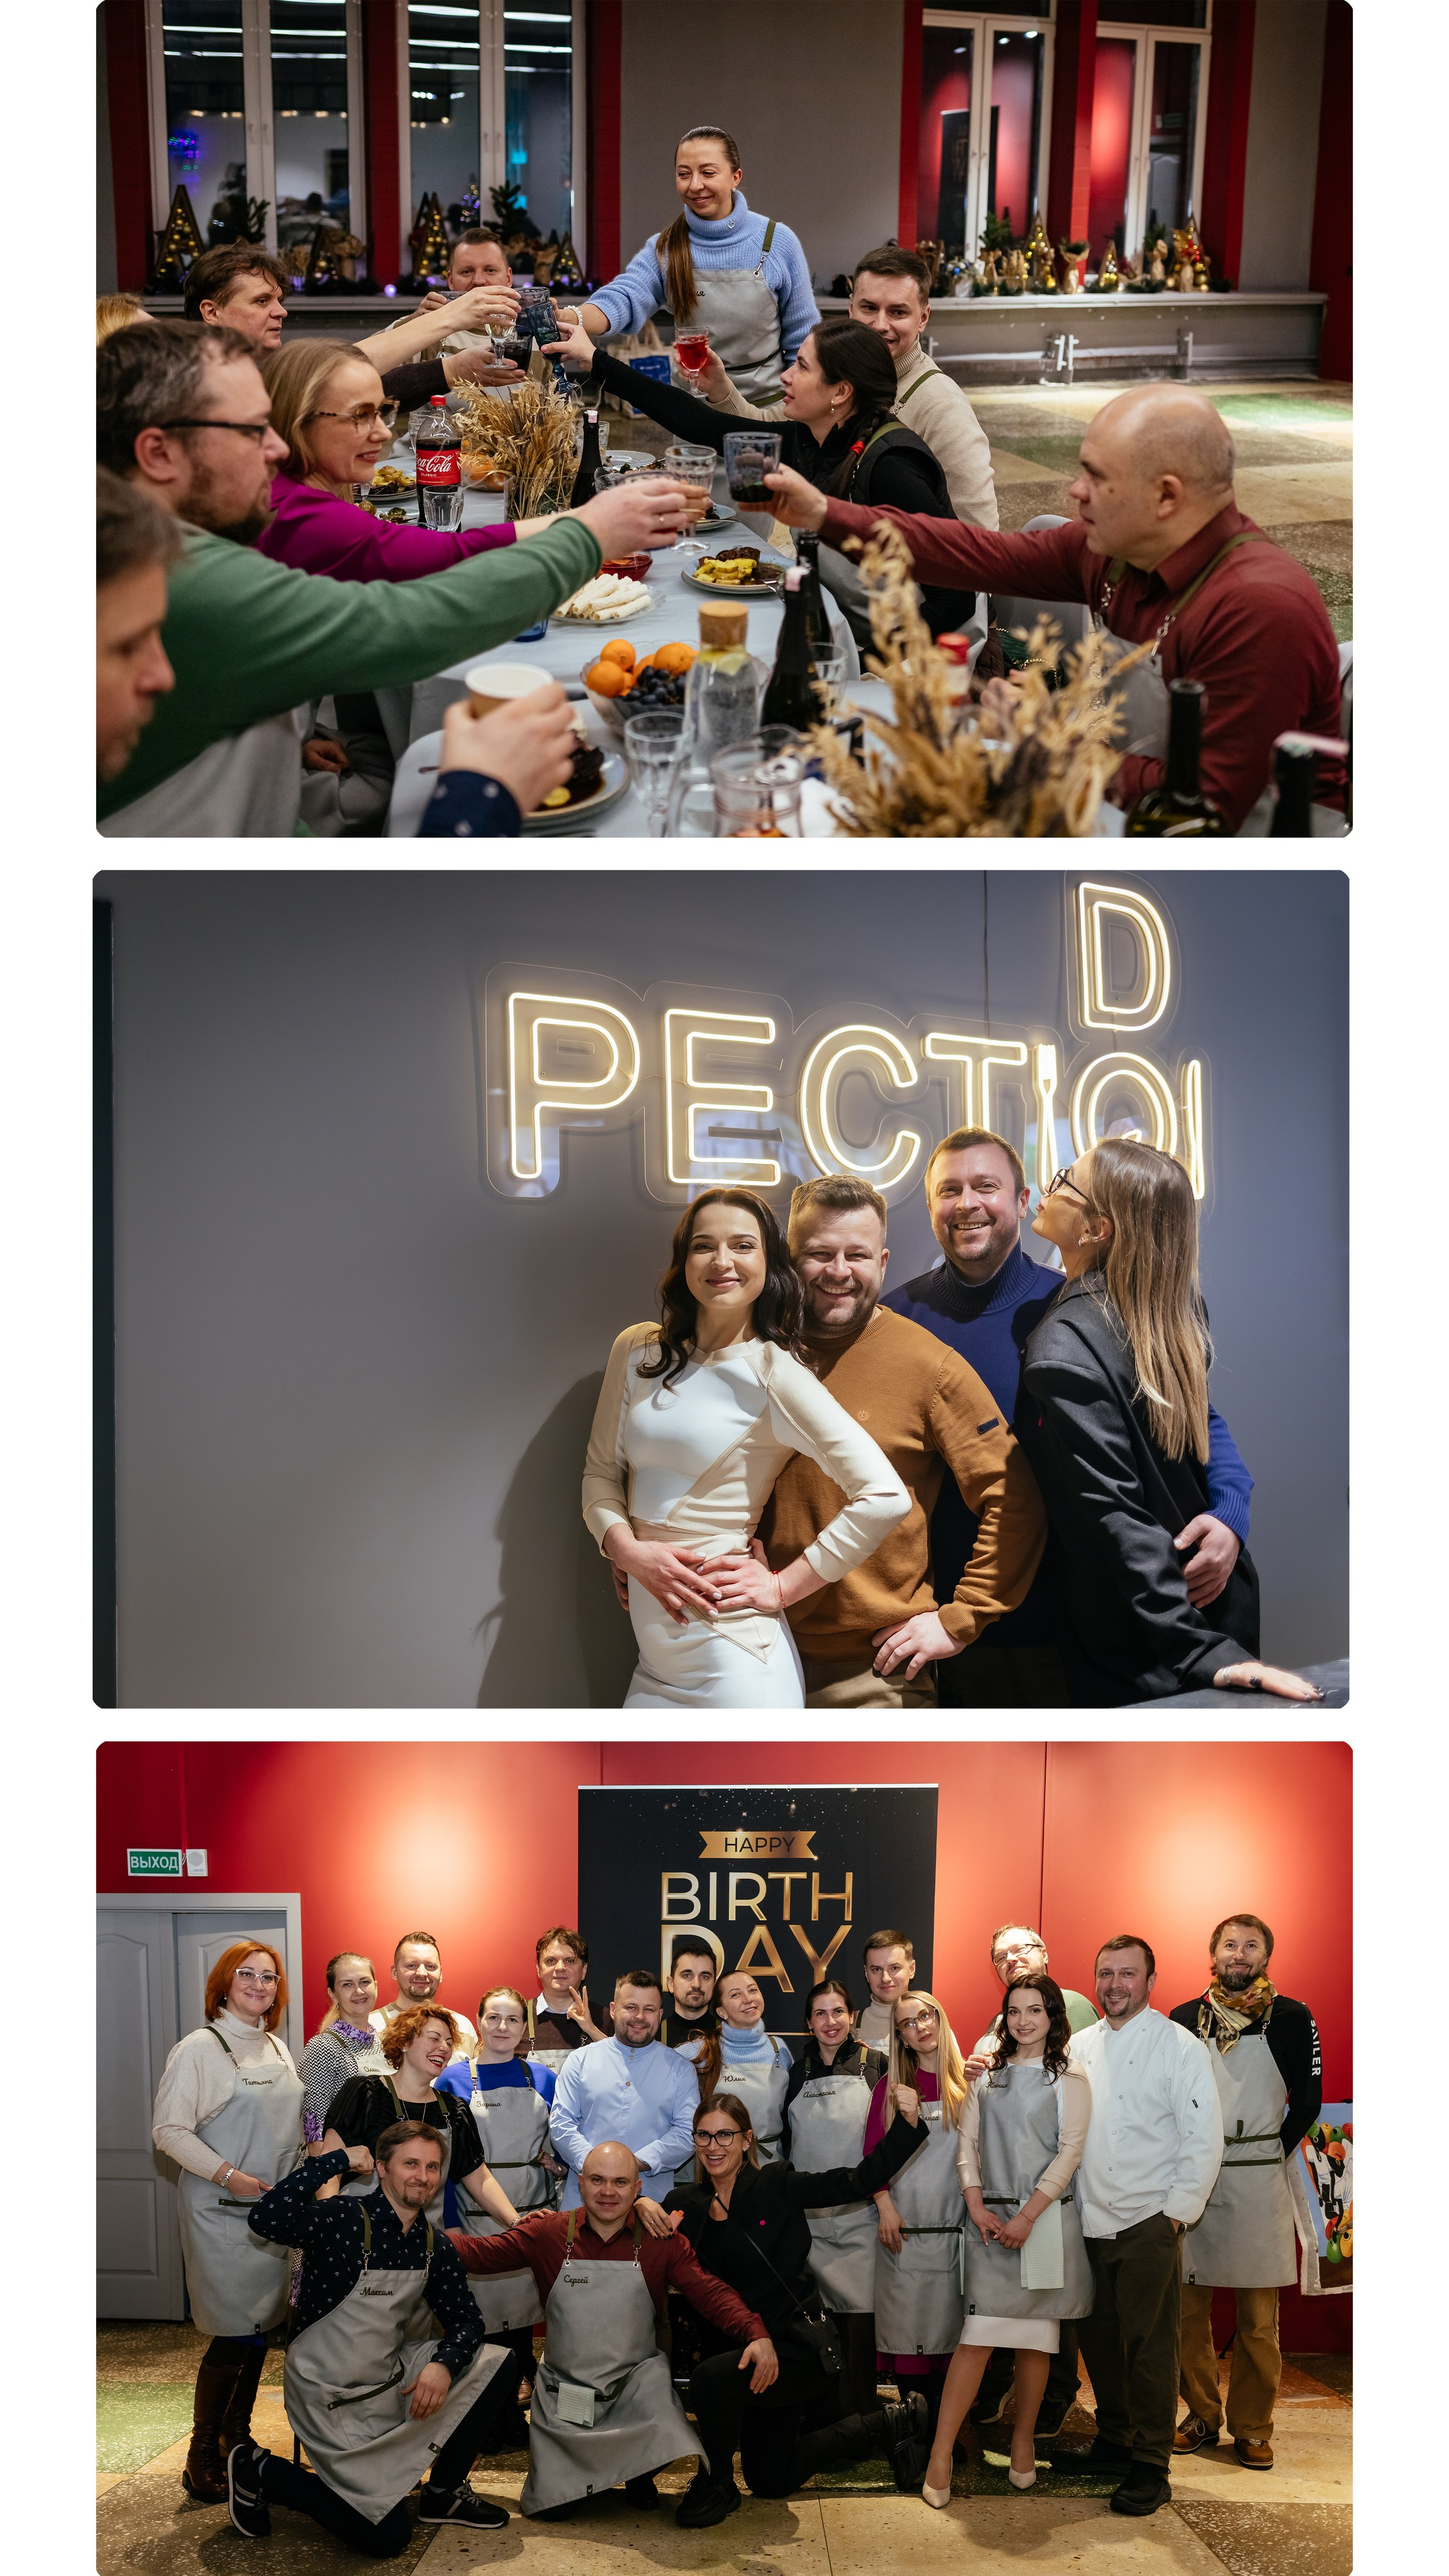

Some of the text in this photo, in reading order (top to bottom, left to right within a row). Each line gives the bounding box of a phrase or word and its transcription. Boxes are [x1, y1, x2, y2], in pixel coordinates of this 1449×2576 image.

[724, 1836, 796, 1853] HAPPY
[130, 1856, 178, 1871] ВЫХОД
[661, 1872, 853, 1921] BIRTH
[661, 1924, 853, 1993] DAY
[1311, 2019, 1321, 2076] SAILER
[476, 2101, 502, 2110] Зарина
[564, 2274, 589, 2287] Сергей
[359, 2286, 394, 2296] Максим
